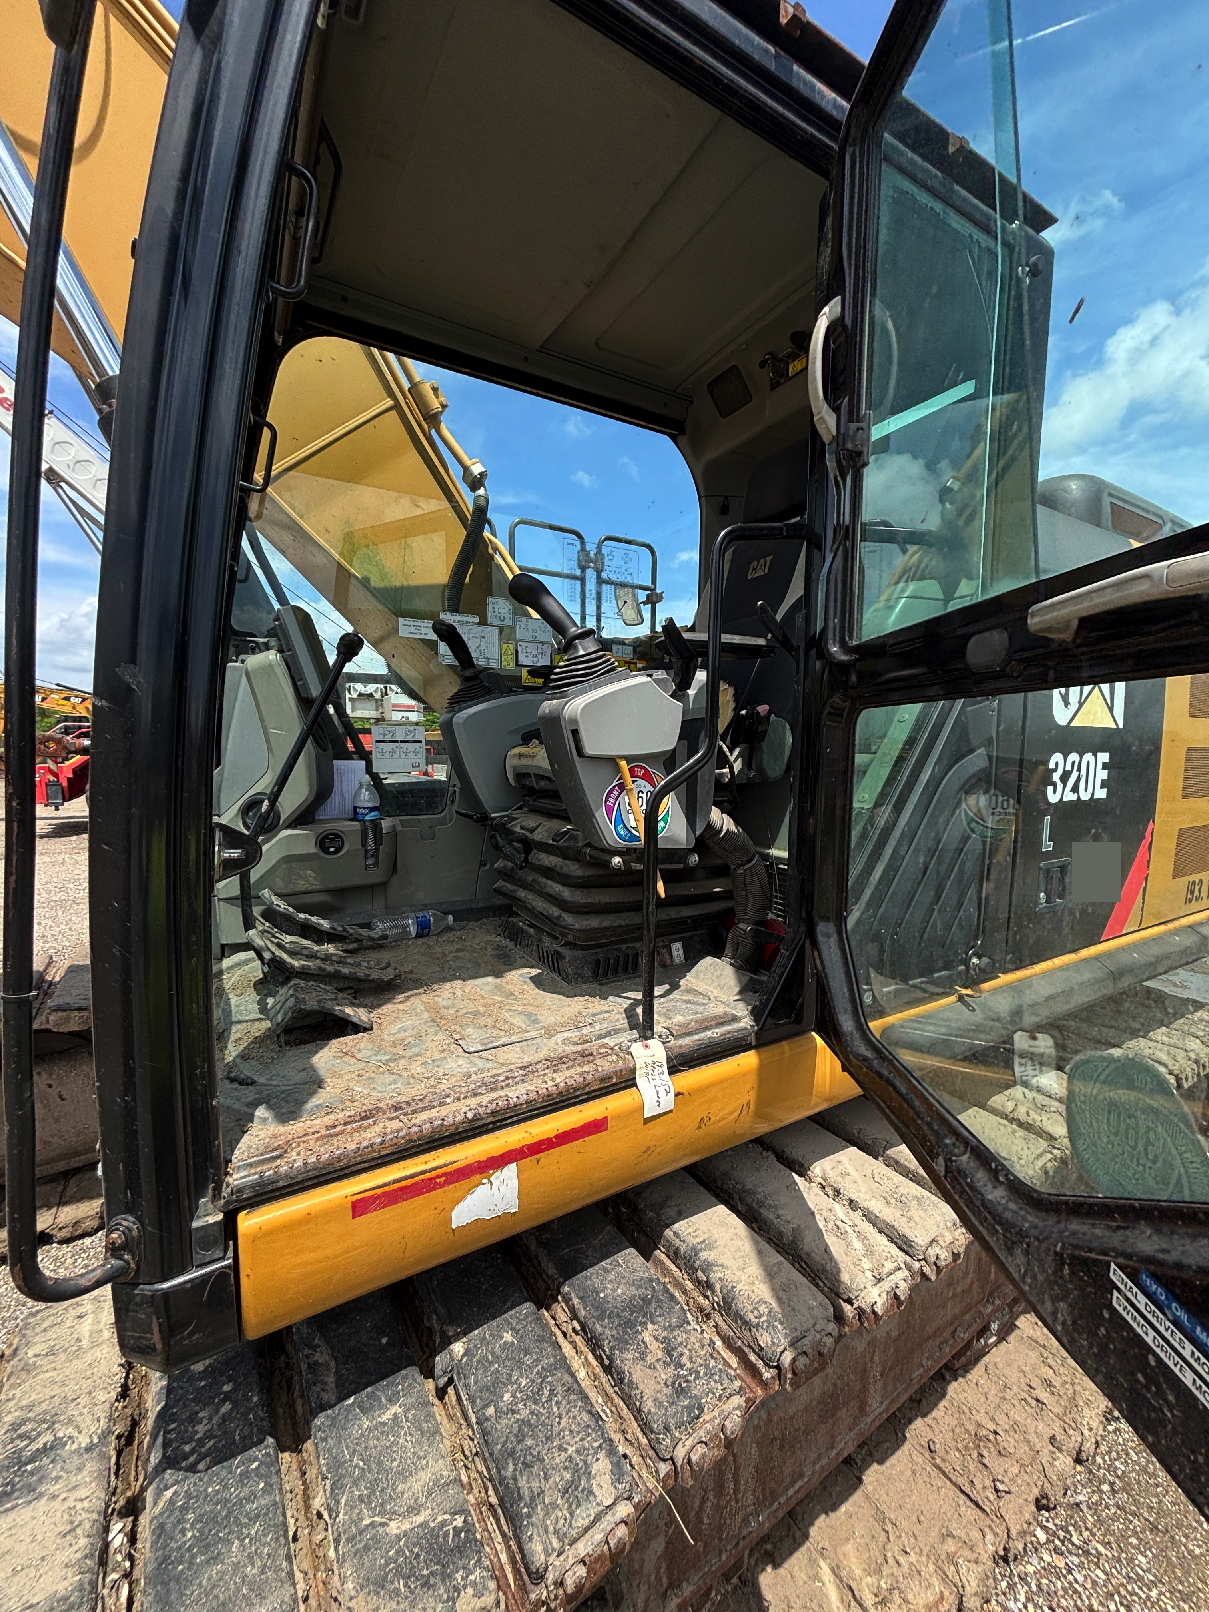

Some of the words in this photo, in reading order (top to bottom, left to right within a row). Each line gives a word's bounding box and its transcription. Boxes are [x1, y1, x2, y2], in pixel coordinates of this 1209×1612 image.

[747, 554, 774, 580] CAT
[634, 767, 645, 776] TOP
[1046, 752, 1110, 804] 320E
[606, 787, 621, 806] FRONT
[617, 824, 631, 840] SIDES
[1041, 816, 1054, 852] L
[1112, 1267, 1141, 1303] FINAL
[1144, 1303, 1186, 1350] DRIVES
[1141, 1272, 1168, 1304] HYD.
[1171, 1305, 1191, 1327] OIL
[1115, 1296, 1149, 1338] SWING
[1152, 1336, 1188, 1378] DRIVE
